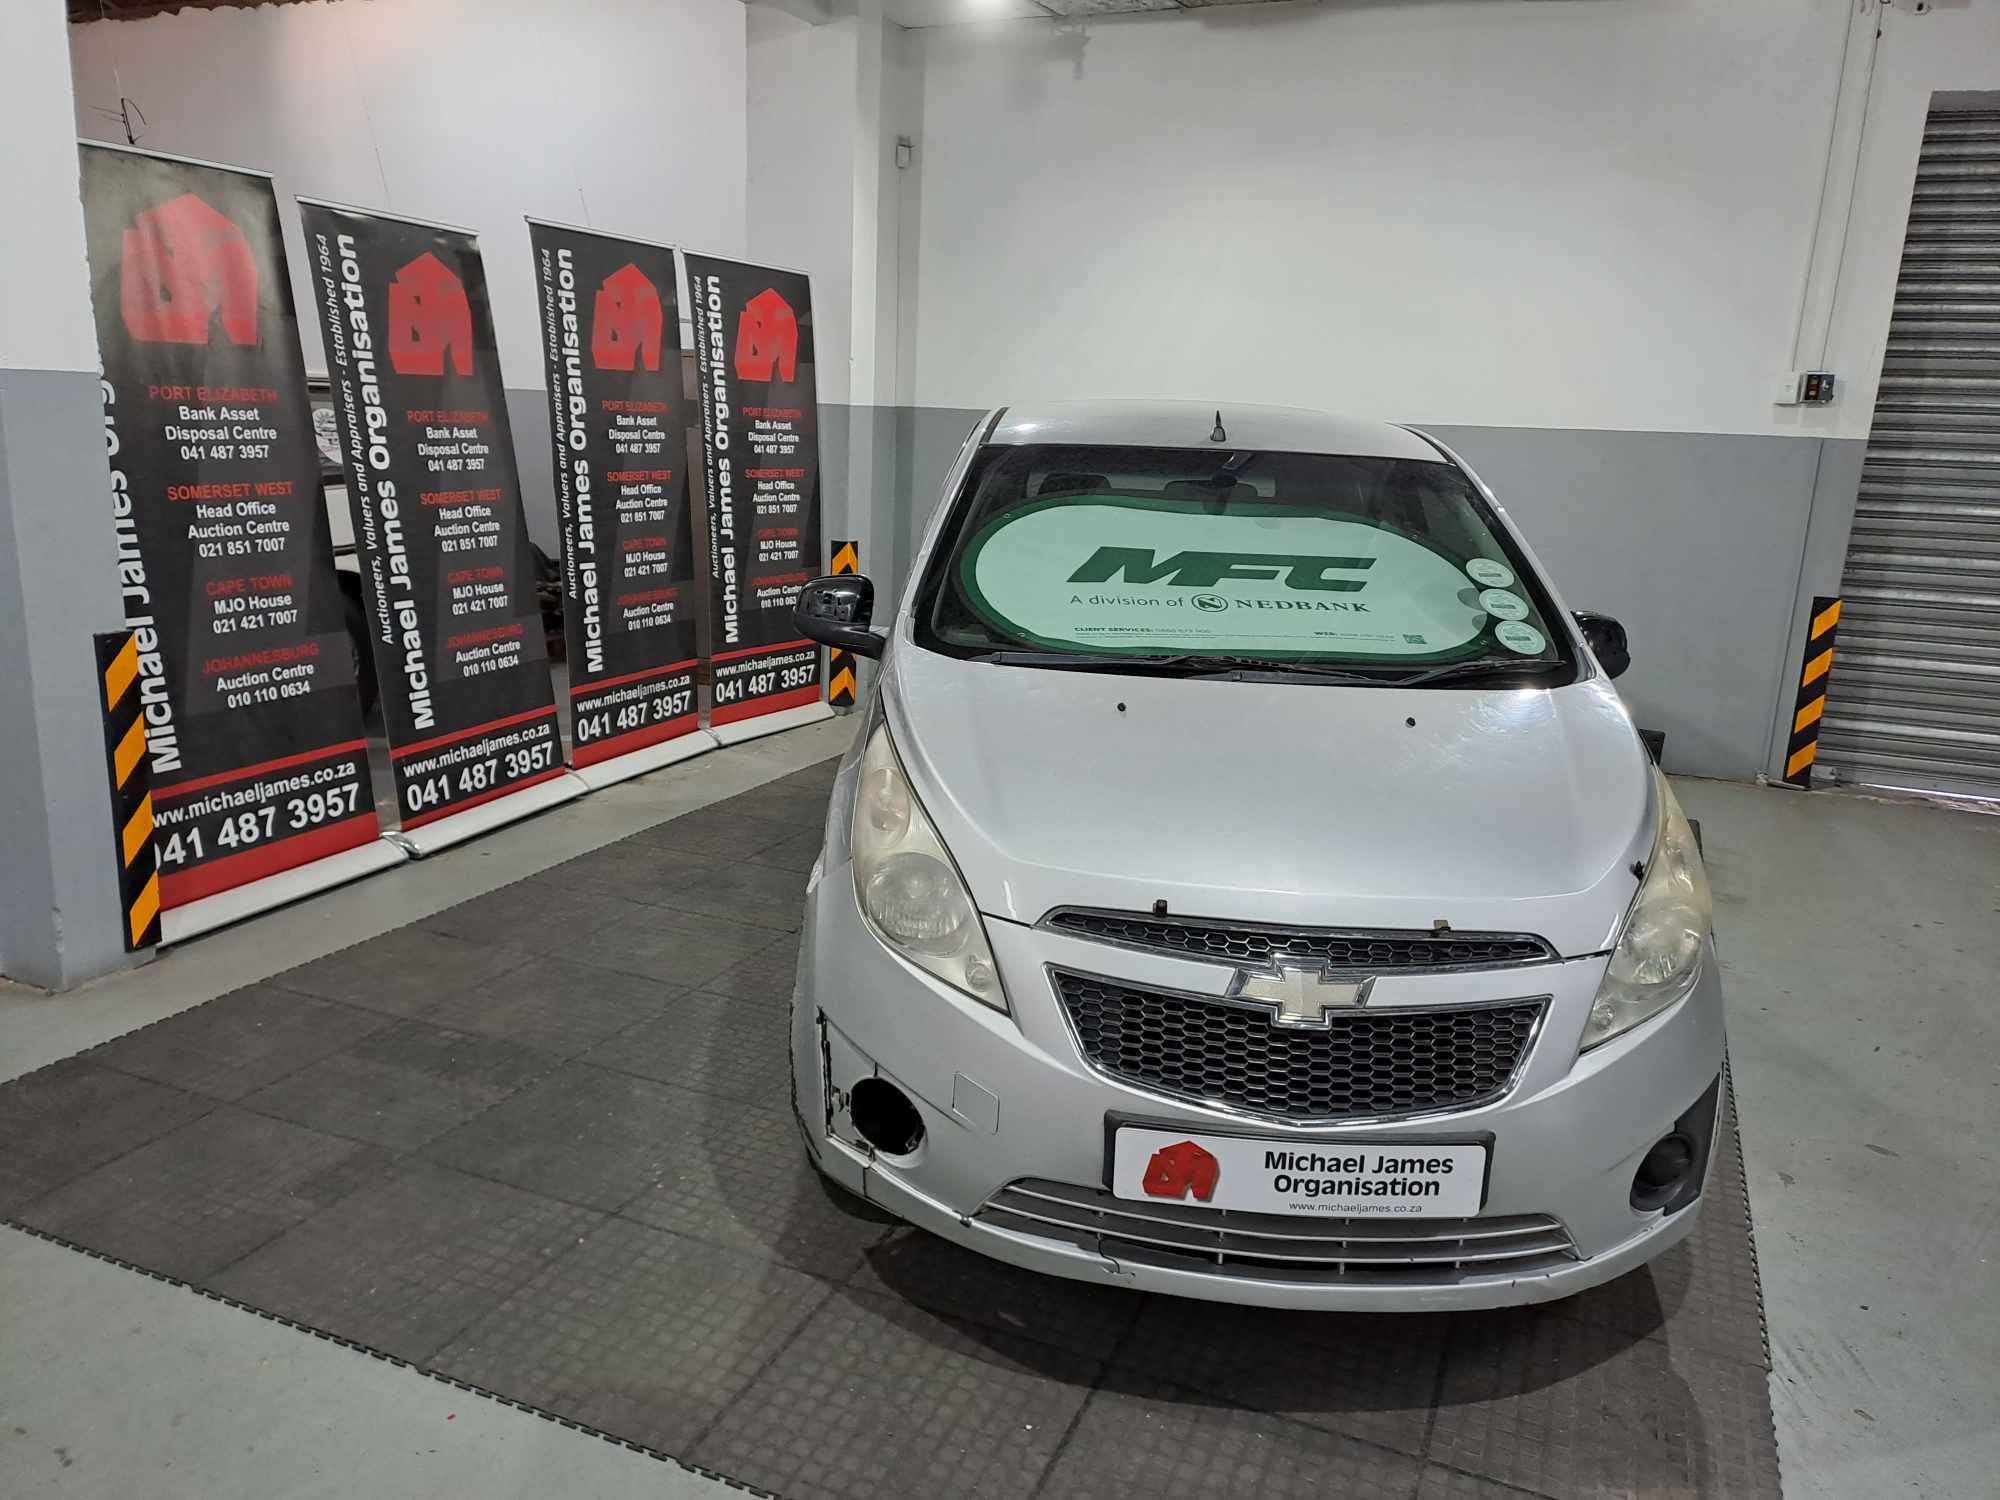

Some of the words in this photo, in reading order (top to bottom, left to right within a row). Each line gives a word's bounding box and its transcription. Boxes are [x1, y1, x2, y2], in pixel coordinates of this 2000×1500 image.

[316, 233, 332, 273] 1964
[541, 248, 553, 281] 1964
[322, 276, 348, 366] Established
[543, 284, 559, 361] Established
[337, 234, 390, 470] Organisation
[557, 248, 587, 451] Organisation
[707, 275, 729, 450] Organisation
[147, 384, 193, 400] PORT
[178, 405, 216, 420] Bank
[220, 406, 260, 421] Asset
[553, 373, 567, 441] Appraisers
[341, 379, 363, 460] Appraisers
[616, 415, 635, 426] Bank
[636, 415, 657, 426] Asset
[165, 425, 229, 443] Disposal
[232, 425, 277, 440] Centre
[426, 427, 451, 439] Bank
[453, 427, 478, 439] Asset
[608, 429, 641, 441] Disposal
[642, 429, 666, 440] Centre
[748, 431, 776, 443] Disposal
[777, 432, 800, 442] Centre
[181, 445, 206, 460] 041
[210, 445, 234, 460] 487
[239, 444, 269, 459] 3957
[417, 442, 459, 457] Disposal
[461, 442, 489, 455] Centre
[556, 443, 567, 469] and
[616, 443, 628, 454] 041
[629, 443, 642, 454] 487
[645, 443, 661, 454] 3957
[704, 443, 713, 466] and
[766, 444, 777, 454] 487
[427, 459, 444, 471] 041
[446, 459, 463, 471] 487
[466, 458, 485, 470] 3957
[352, 462, 368, 492] and
[774, 480, 795, 490] Office
[167, 483, 252, 501] SOMERSET
[255, 481, 293, 496] WEST
[560, 472, 571, 519] Valuers
[620, 485, 639, 496] Head
[640, 484, 662, 494] Office
[718, 458, 734, 540] James
[752, 493, 777, 503] Auction
[778, 492, 801, 502] Centre
[195, 503, 233, 519] Head
[236, 501, 276, 516] Office
[439, 507, 462, 520] Head
[465, 505, 492, 518] Office
[574, 460, 595, 554] James
[615, 499, 643, 510] Auction
[644, 498, 668, 508] Centre
[768, 504, 780, 514] 851
[782, 504, 797, 513] 7007
[188, 522, 243, 539] Auction
[246, 519, 290, 534] Centre
[360, 496, 378, 550] Valuers
[434, 523, 470, 537] Auction
[472, 521, 500, 533] Centre
[110, 470, 150, 604] James
[377, 480, 412, 591] James
[441, 540, 458, 552] 021
[460, 538, 476, 550] 851
[478, 535, 498, 548] 7007
[710, 512, 719, 578] Auctioneers,
[199, 542, 223, 558] 021
[227, 540, 251, 555] 851
[255, 537, 285, 552] 7007
[625, 552, 641, 564] MJO
[642, 551, 666, 561] House
[770, 552, 782, 561] 421
[784, 550, 799, 560] 7007
[565, 523, 577, 599] Auctioneers,
[624, 566, 636, 577] 021
[637, 564, 650, 576] 421
[1066, 546, 1377, 593] MFC
[206, 579, 246, 595] CAPE
[452, 585, 473, 599] MJO
[475, 583, 504, 595] House
[720, 547, 739, 643] Michael
[214, 597, 246, 614] MJO
[248, 594, 292, 610] House
[371, 555, 394, 645] Auctioneers,
[452, 602, 468, 615] 021
[470, 599, 486, 612] 421
[488, 595, 508, 608] 7007
[623, 605, 650, 618] Auction
[651, 602, 675, 613] Centre
[1070, 594, 1083, 605] A
[1089, 594, 1160, 608] division
[1166, 595, 1184, 608] of
[1234, 599, 1373, 613] NEDBANK
[213, 618, 236, 634] 021
[240, 614, 264, 630] 421
[268, 609, 298, 626] 7007
[579, 562, 603, 673] Michael
[642, 617, 654, 628] 110
[455, 647, 491, 663] Auction
[492, 640, 521, 655] Centre
[394, 600, 436, 730] Michael
[463, 663, 479, 677] 010
[481, 659, 496, 673] 110
[498, 654, 519, 669] 0634
[715, 650, 815, 678] www.michaeljames.co.za
[216, 672, 269, 692] Auction
[272, 663, 315, 681] Centre
[715, 678, 744, 703] 041
[748, 672, 776, 695] 487
[781, 664, 815, 688] 3957
[126, 615, 183, 774] Michael
[227, 691, 252, 708] 010
[254, 686, 278, 702] 110
[281, 680, 311, 698] 0634
[577, 675, 690, 713] www.michaeljames.co.za
[577, 712, 610, 742] 041
[617, 702, 648, 730] 487
[652, 690, 691, 720] 3957
[403, 723, 550, 778] www.michaeljames.co.za
[407, 774, 450, 812] 041
[458, 758, 498, 793] 487
[504, 741, 553, 778] 3957
[153, 761, 356, 829] ww.michaeljames.co.za
[217, 806, 276, 848] 487
[287, 782, 359, 829] 3957
[1264, 1150, 1365, 1174] Michael
[1371, 1154, 1454, 1175] James
[1273, 1175, 1440, 1198] Organisation
[1289, 1202, 1423, 1214] www.michaeljames.co.za
